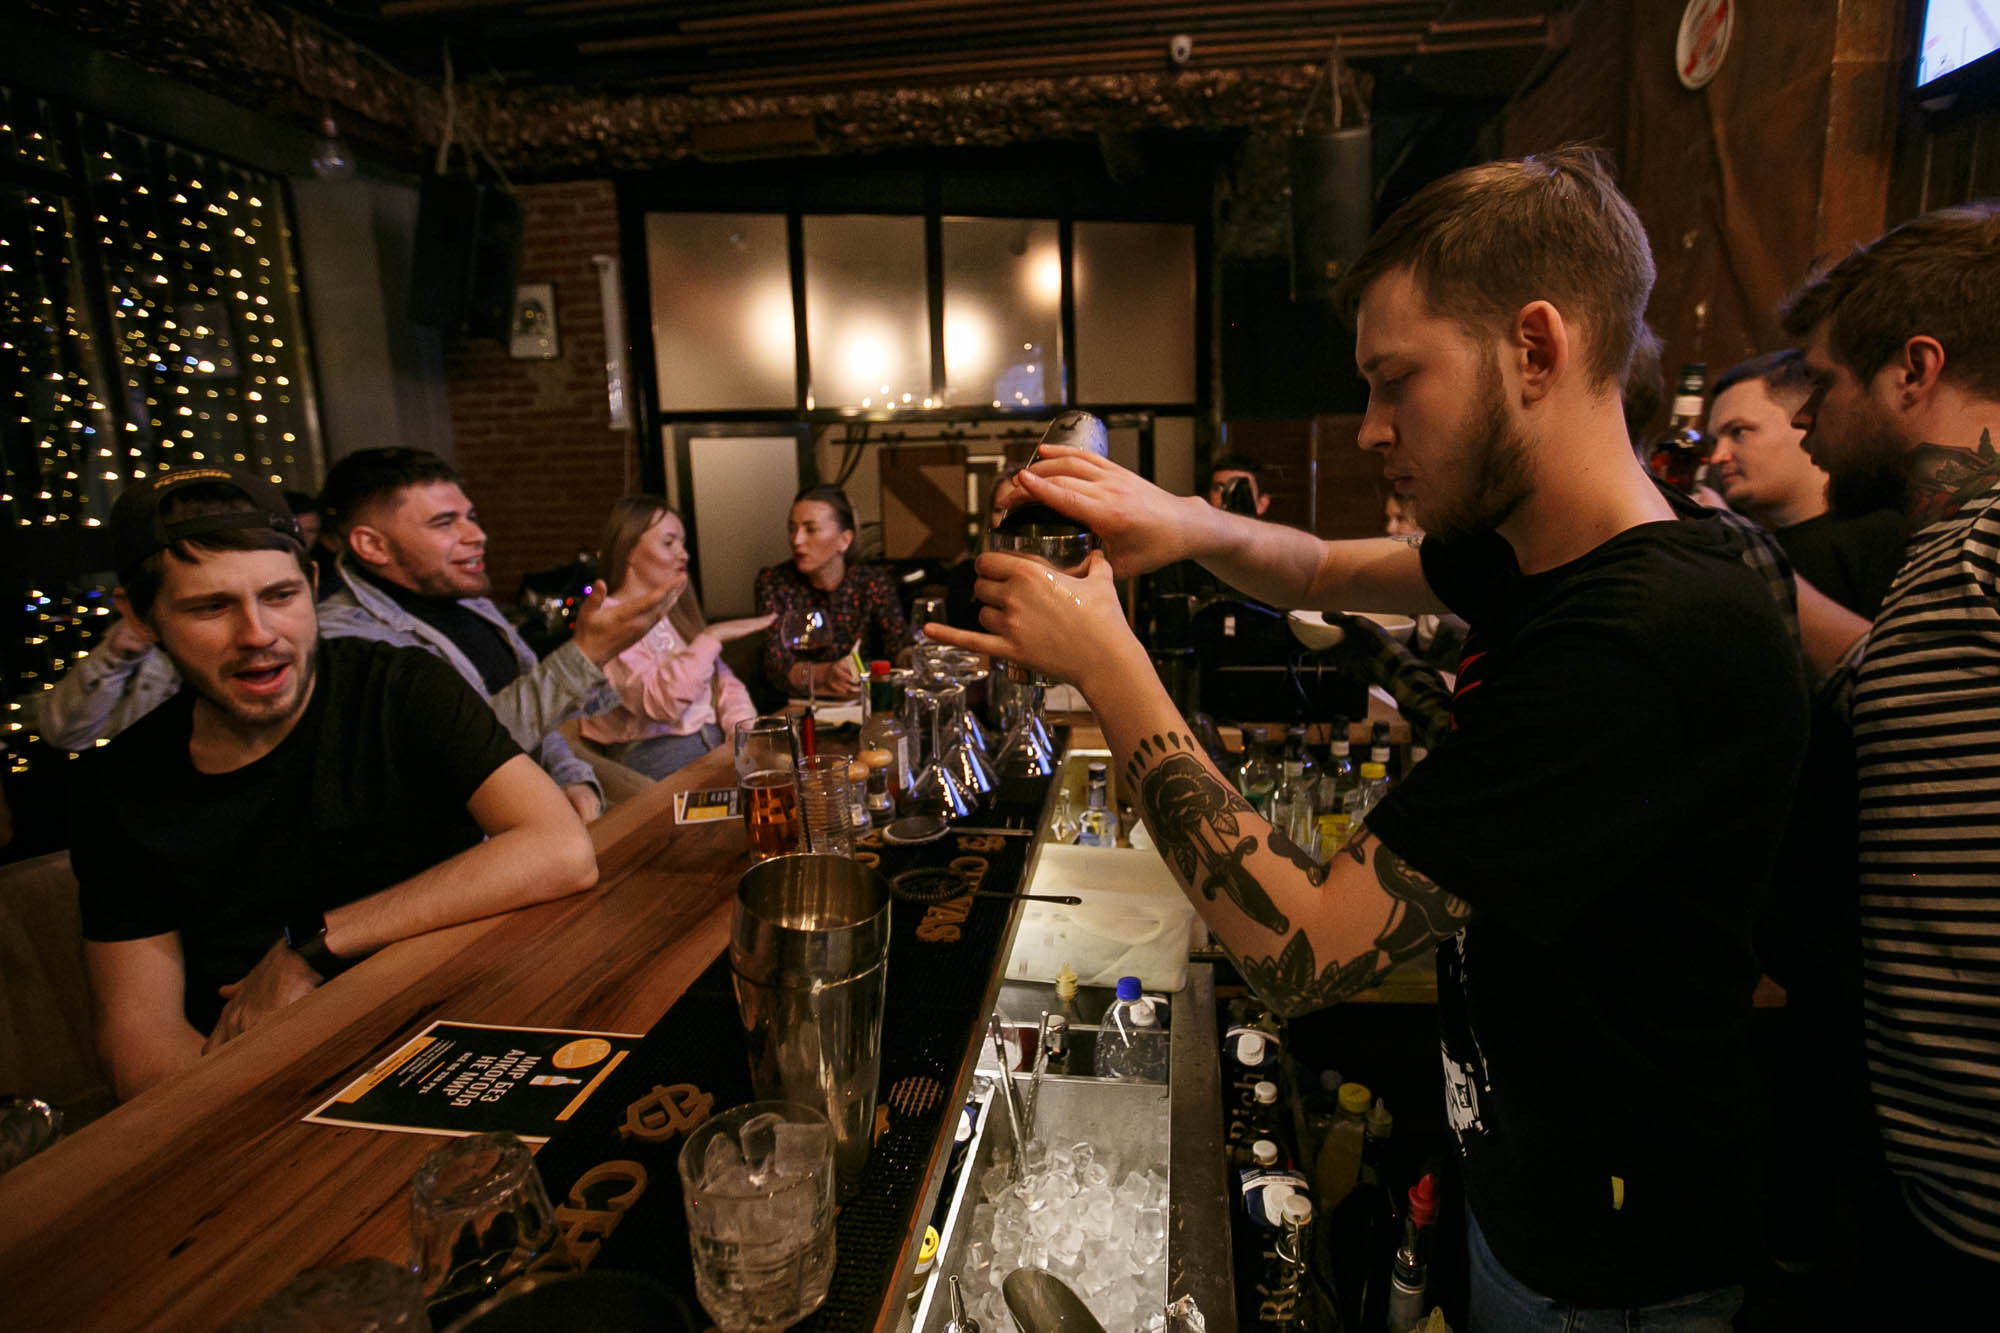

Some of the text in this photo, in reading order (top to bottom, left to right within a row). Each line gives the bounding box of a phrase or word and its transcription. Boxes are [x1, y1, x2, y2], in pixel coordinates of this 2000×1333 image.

[915, 856, 989, 943] CVAS
[442, 1071, 479, 1096] МИР
[449, 1048, 527, 1108] АЛКОГОЛЯ
[469, 1056, 498, 1070] НЕ
[480, 1055, 542, 1103] МИР БЕЗ
